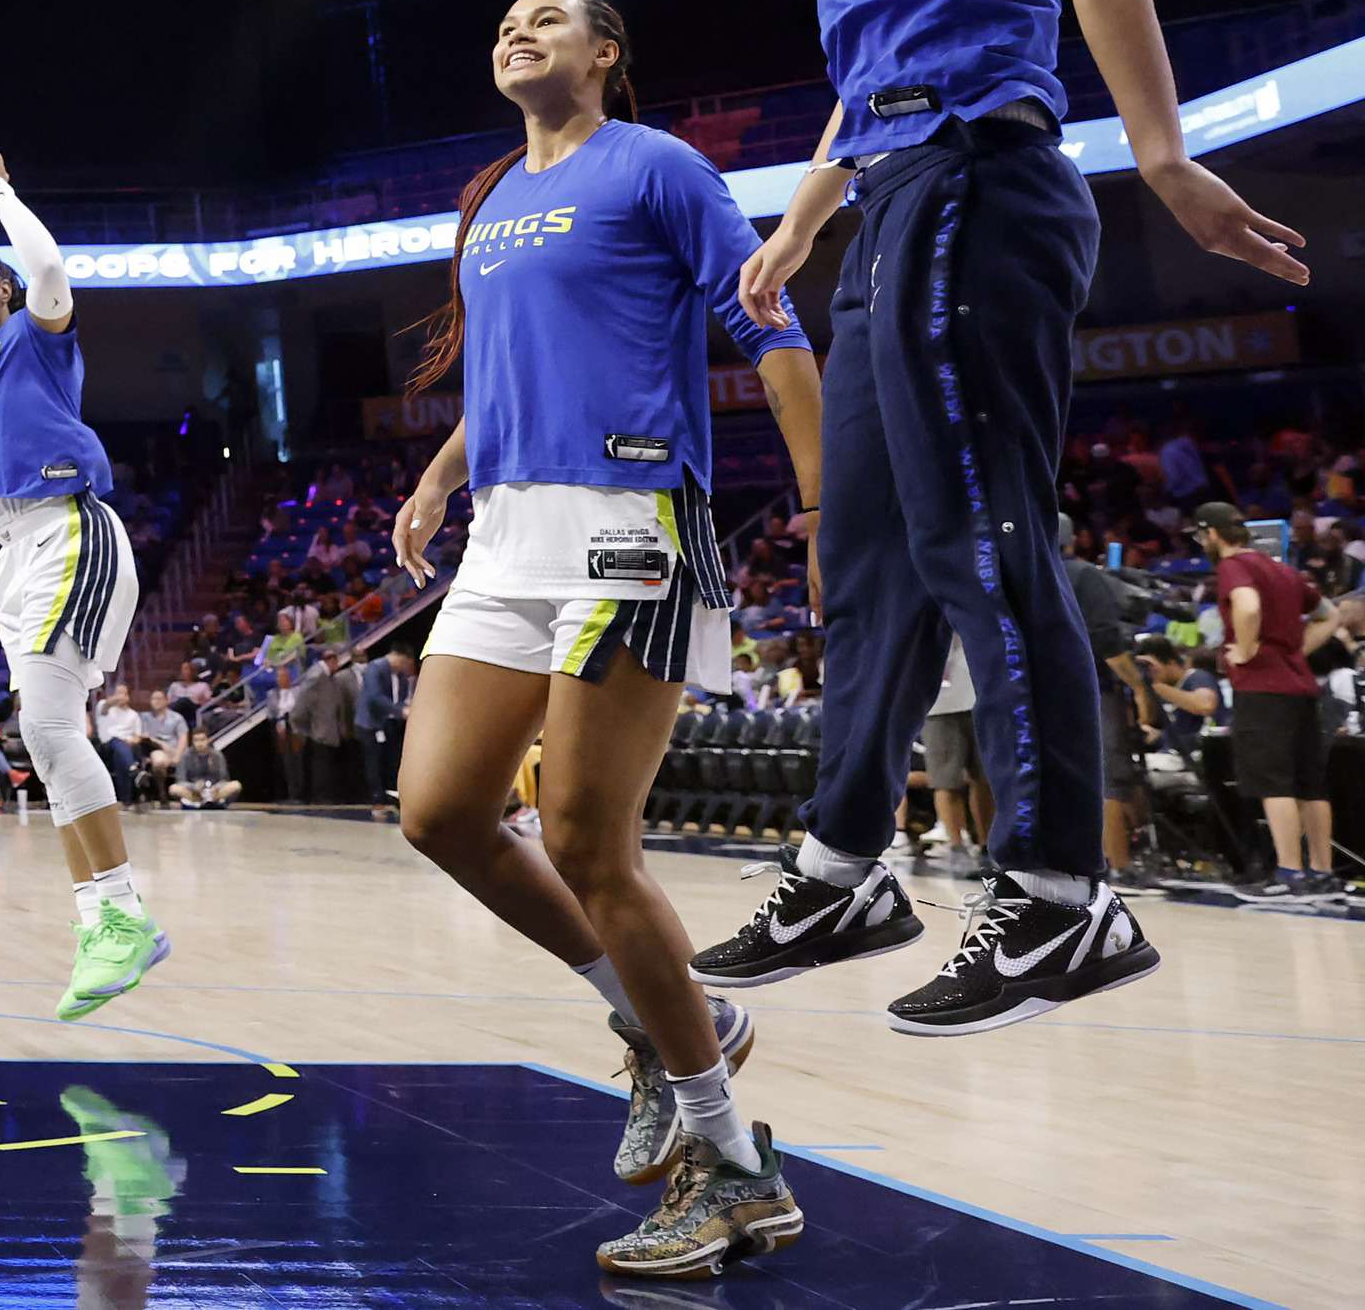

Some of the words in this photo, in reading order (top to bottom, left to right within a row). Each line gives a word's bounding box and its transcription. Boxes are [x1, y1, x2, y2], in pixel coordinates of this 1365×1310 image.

[65, 252, 190, 279] OOPS
[208, 246, 297, 277] FOR
[312, 222, 458, 267] HEROE
[930, 280, 947, 341] WNBA
[939, 362, 963, 425] WNBA
[959, 447, 983, 513] WNBA
[599, 528, 626, 536] DALLAS
[977, 534, 997, 594] WNBA
[1013, 705, 1033, 774] WNBA
[1016, 799, 1032, 838] WN
